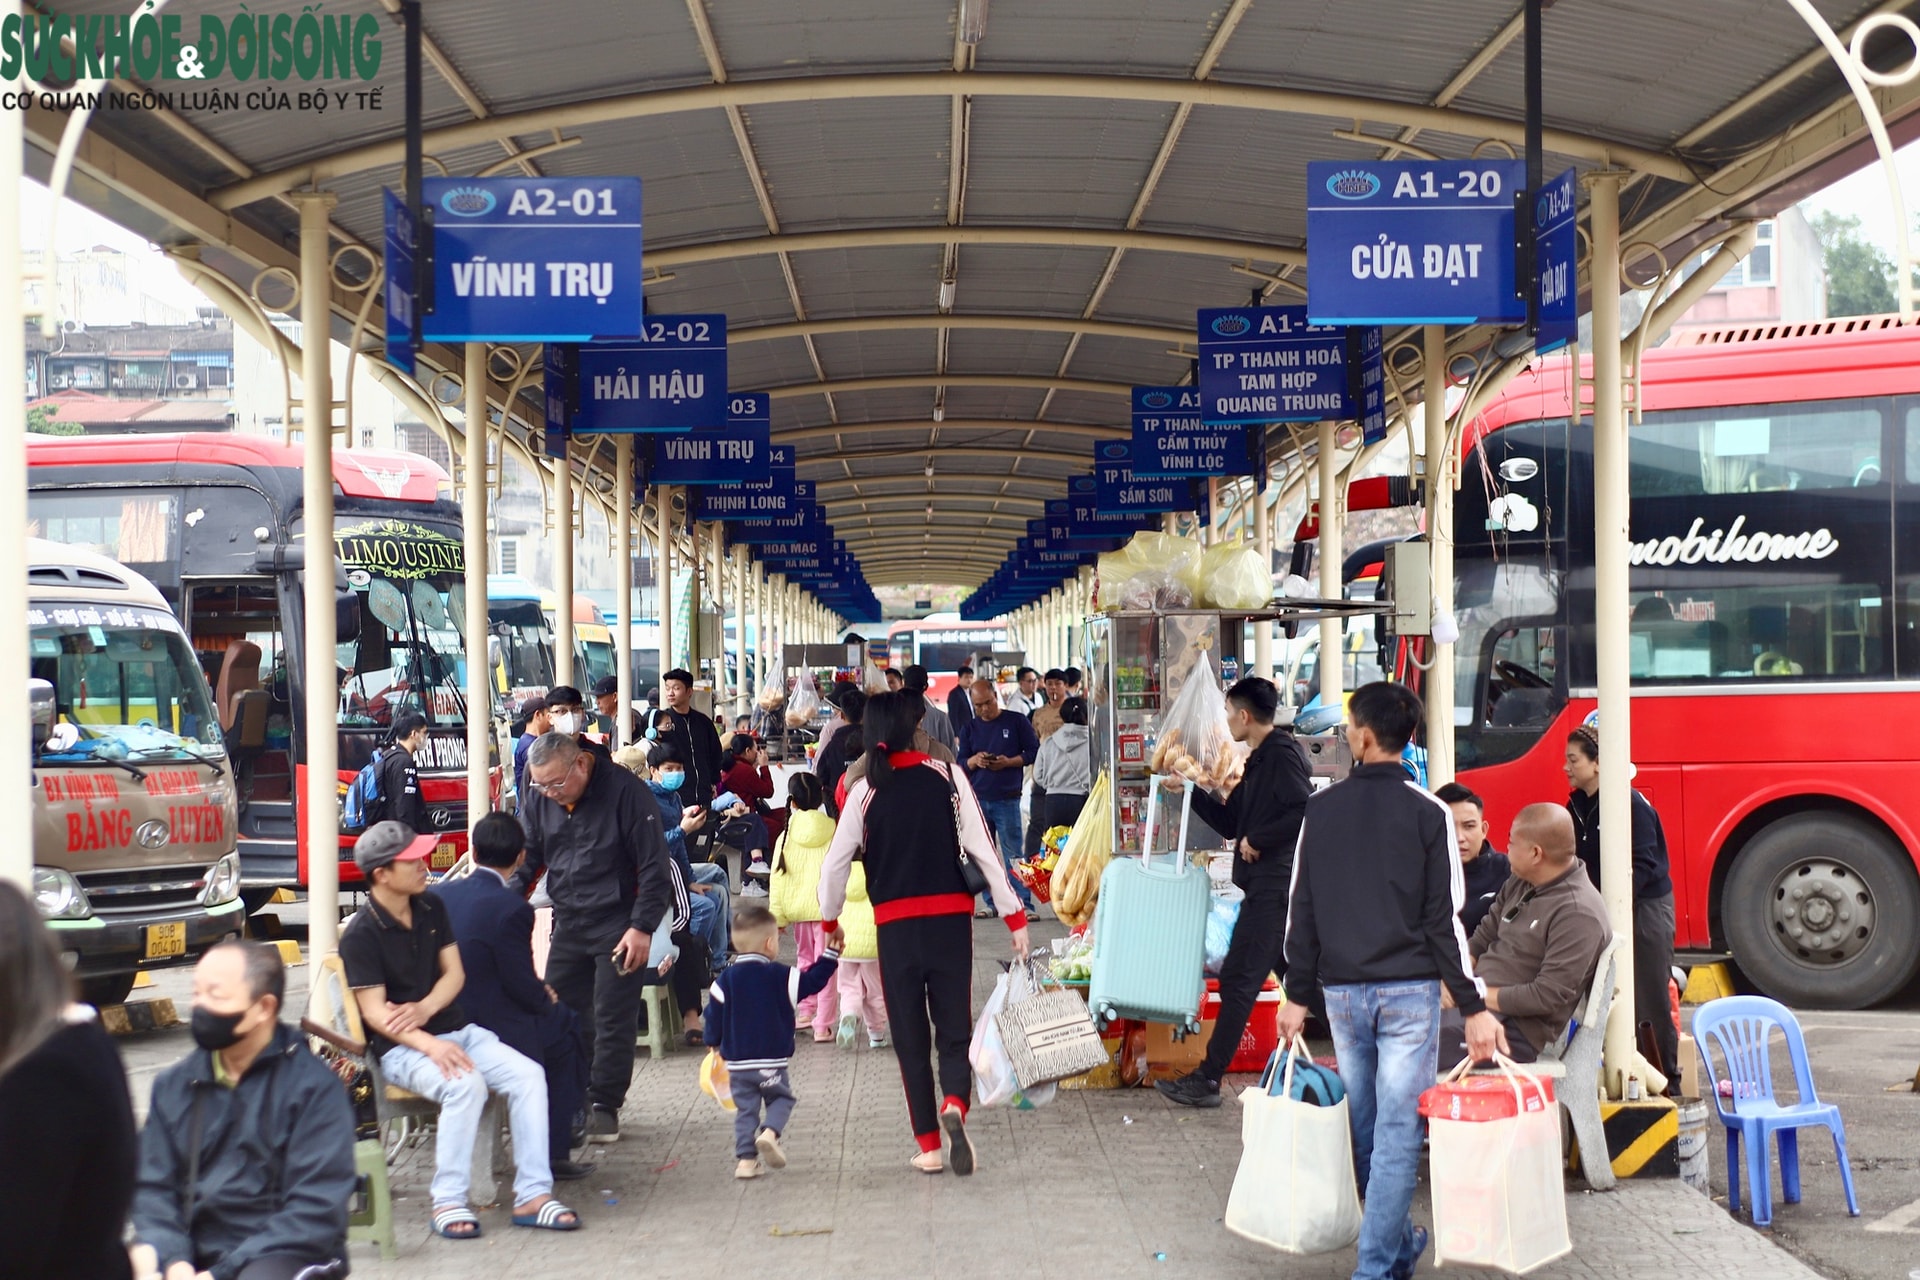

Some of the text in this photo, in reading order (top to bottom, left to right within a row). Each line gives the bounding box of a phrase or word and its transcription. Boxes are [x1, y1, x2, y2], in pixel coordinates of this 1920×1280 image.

[1392, 170, 1501, 198] A1-20
[507, 188, 617, 216] A2-01
[1548, 182, 1570, 220] A1-20
[1351, 233, 1482, 286] CỬA ĐẠT
[451, 256, 613, 304] VĨNH TRỤ
[1213, 346, 1342, 369] TP THANH HOÁ
[594, 367, 704, 404] HẢI HẬU
[1238, 371, 1318, 391] TAM HỢP
[1216, 394, 1342, 416] QUANG TRUNG
[1143, 419, 1160, 431] TP
[665, 437, 711, 460] VĨNH
[717, 440, 754, 463] TRỤ
[1157, 433, 1189, 450] CẨM
[1161, 453, 1224, 471] VĨNH LỘC
[1104, 470, 1118, 483] TP
[706, 496, 786, 512] THỊNH LONG
[1149, 488, 1173, 503] SƠN
[1075, 508, 1089, 521] TP.
[1629, 514, 1839, 566] mobihome
[335, 539, 465, 570] LIMOUSINE
[433, 737, 467, 767] PHONG
[43, 769, 120, 803] BX VĨNH TRỤ
